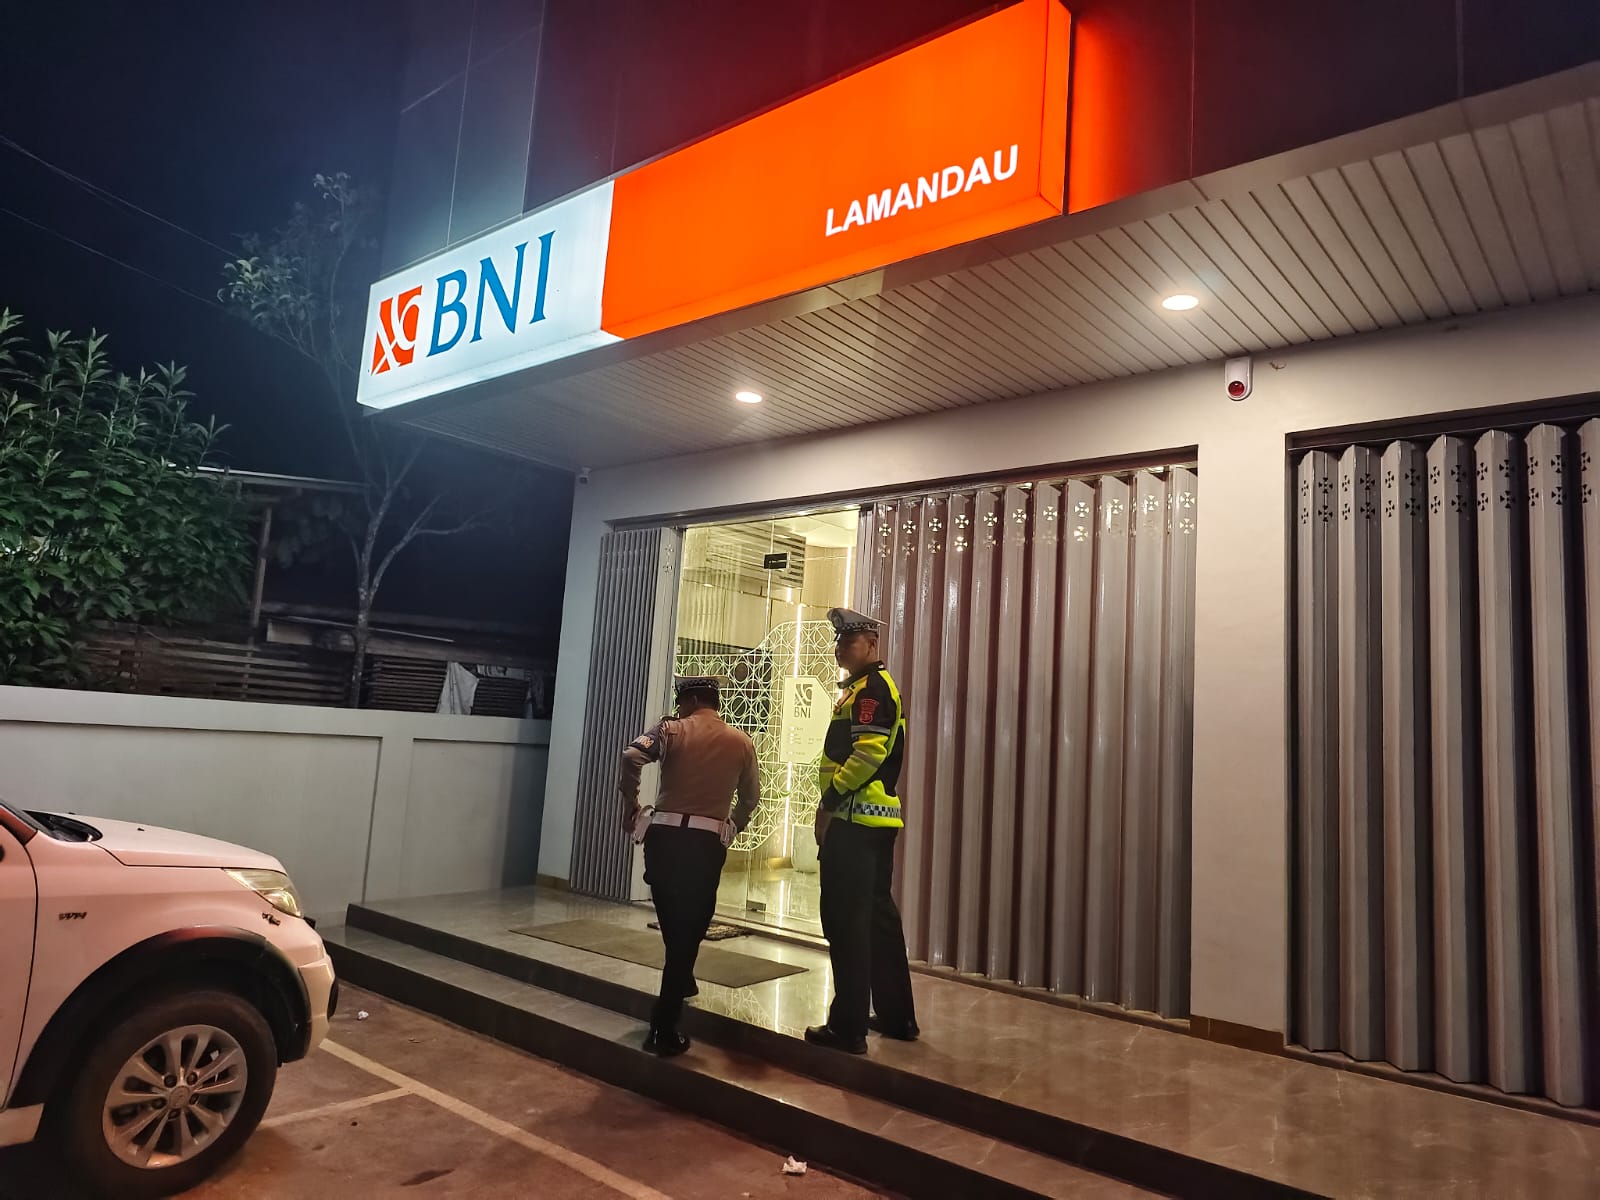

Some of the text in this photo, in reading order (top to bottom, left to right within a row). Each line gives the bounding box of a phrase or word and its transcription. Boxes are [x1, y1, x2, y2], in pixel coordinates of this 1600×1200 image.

[825, 144, 1018, 237] LAMANDAU
[426, 230, 556, 358] BNI
[794, 707, 811, 718] BNI
